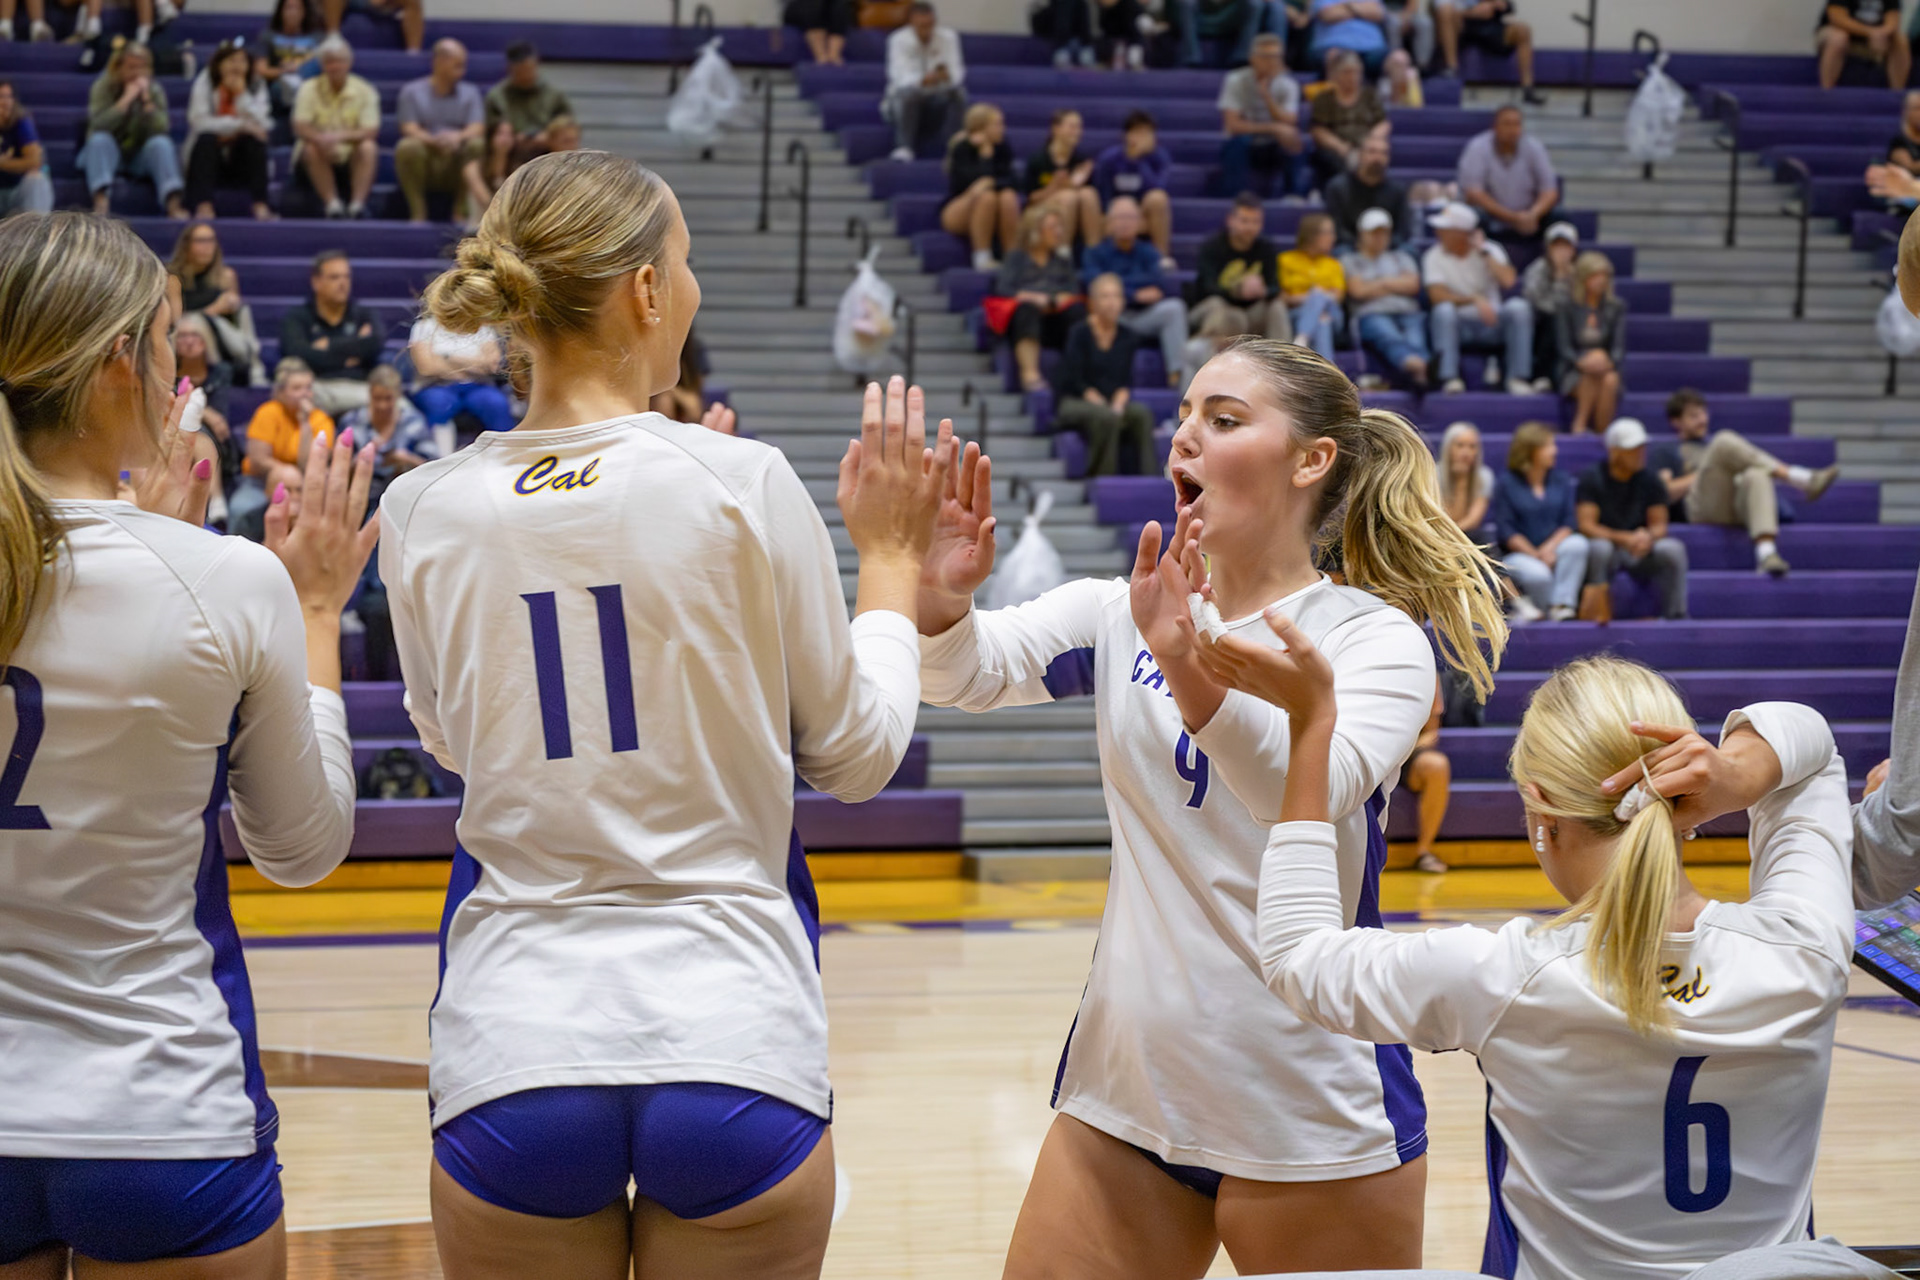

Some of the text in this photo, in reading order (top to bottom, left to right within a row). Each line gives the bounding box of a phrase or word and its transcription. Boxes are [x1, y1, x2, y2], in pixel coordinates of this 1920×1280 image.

[512, 455, 601, 497] Cal
[518, 583, 640, 761] 11
[1131, 649, 1175, 698] CA
[1174, 728, 1210, 810] 9
[1663, 1054, 1732, 1214] 6
